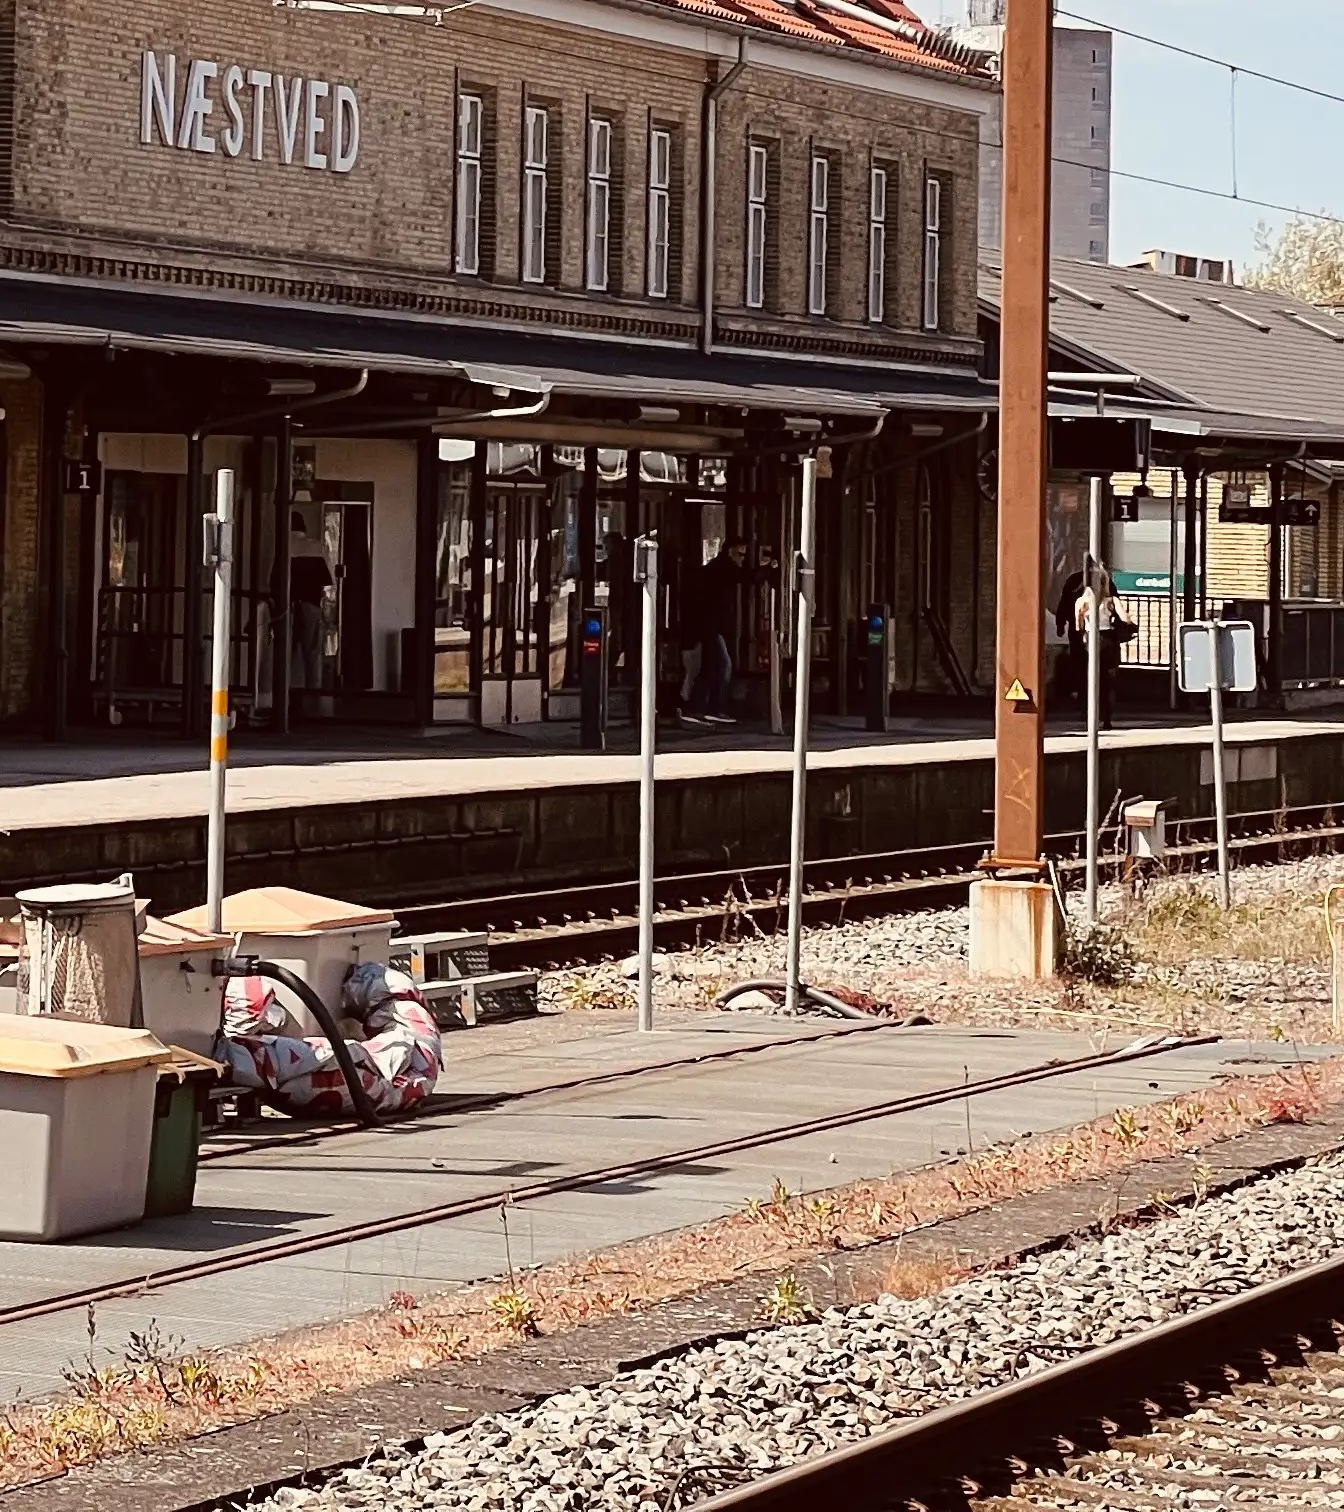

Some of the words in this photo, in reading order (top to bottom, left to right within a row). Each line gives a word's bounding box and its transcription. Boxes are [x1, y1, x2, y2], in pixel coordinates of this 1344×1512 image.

[141, 50, 360, 173] NÆSTVED
[79, 470, 91, 489] 1
[1120, 504, 1131, 519] 1
